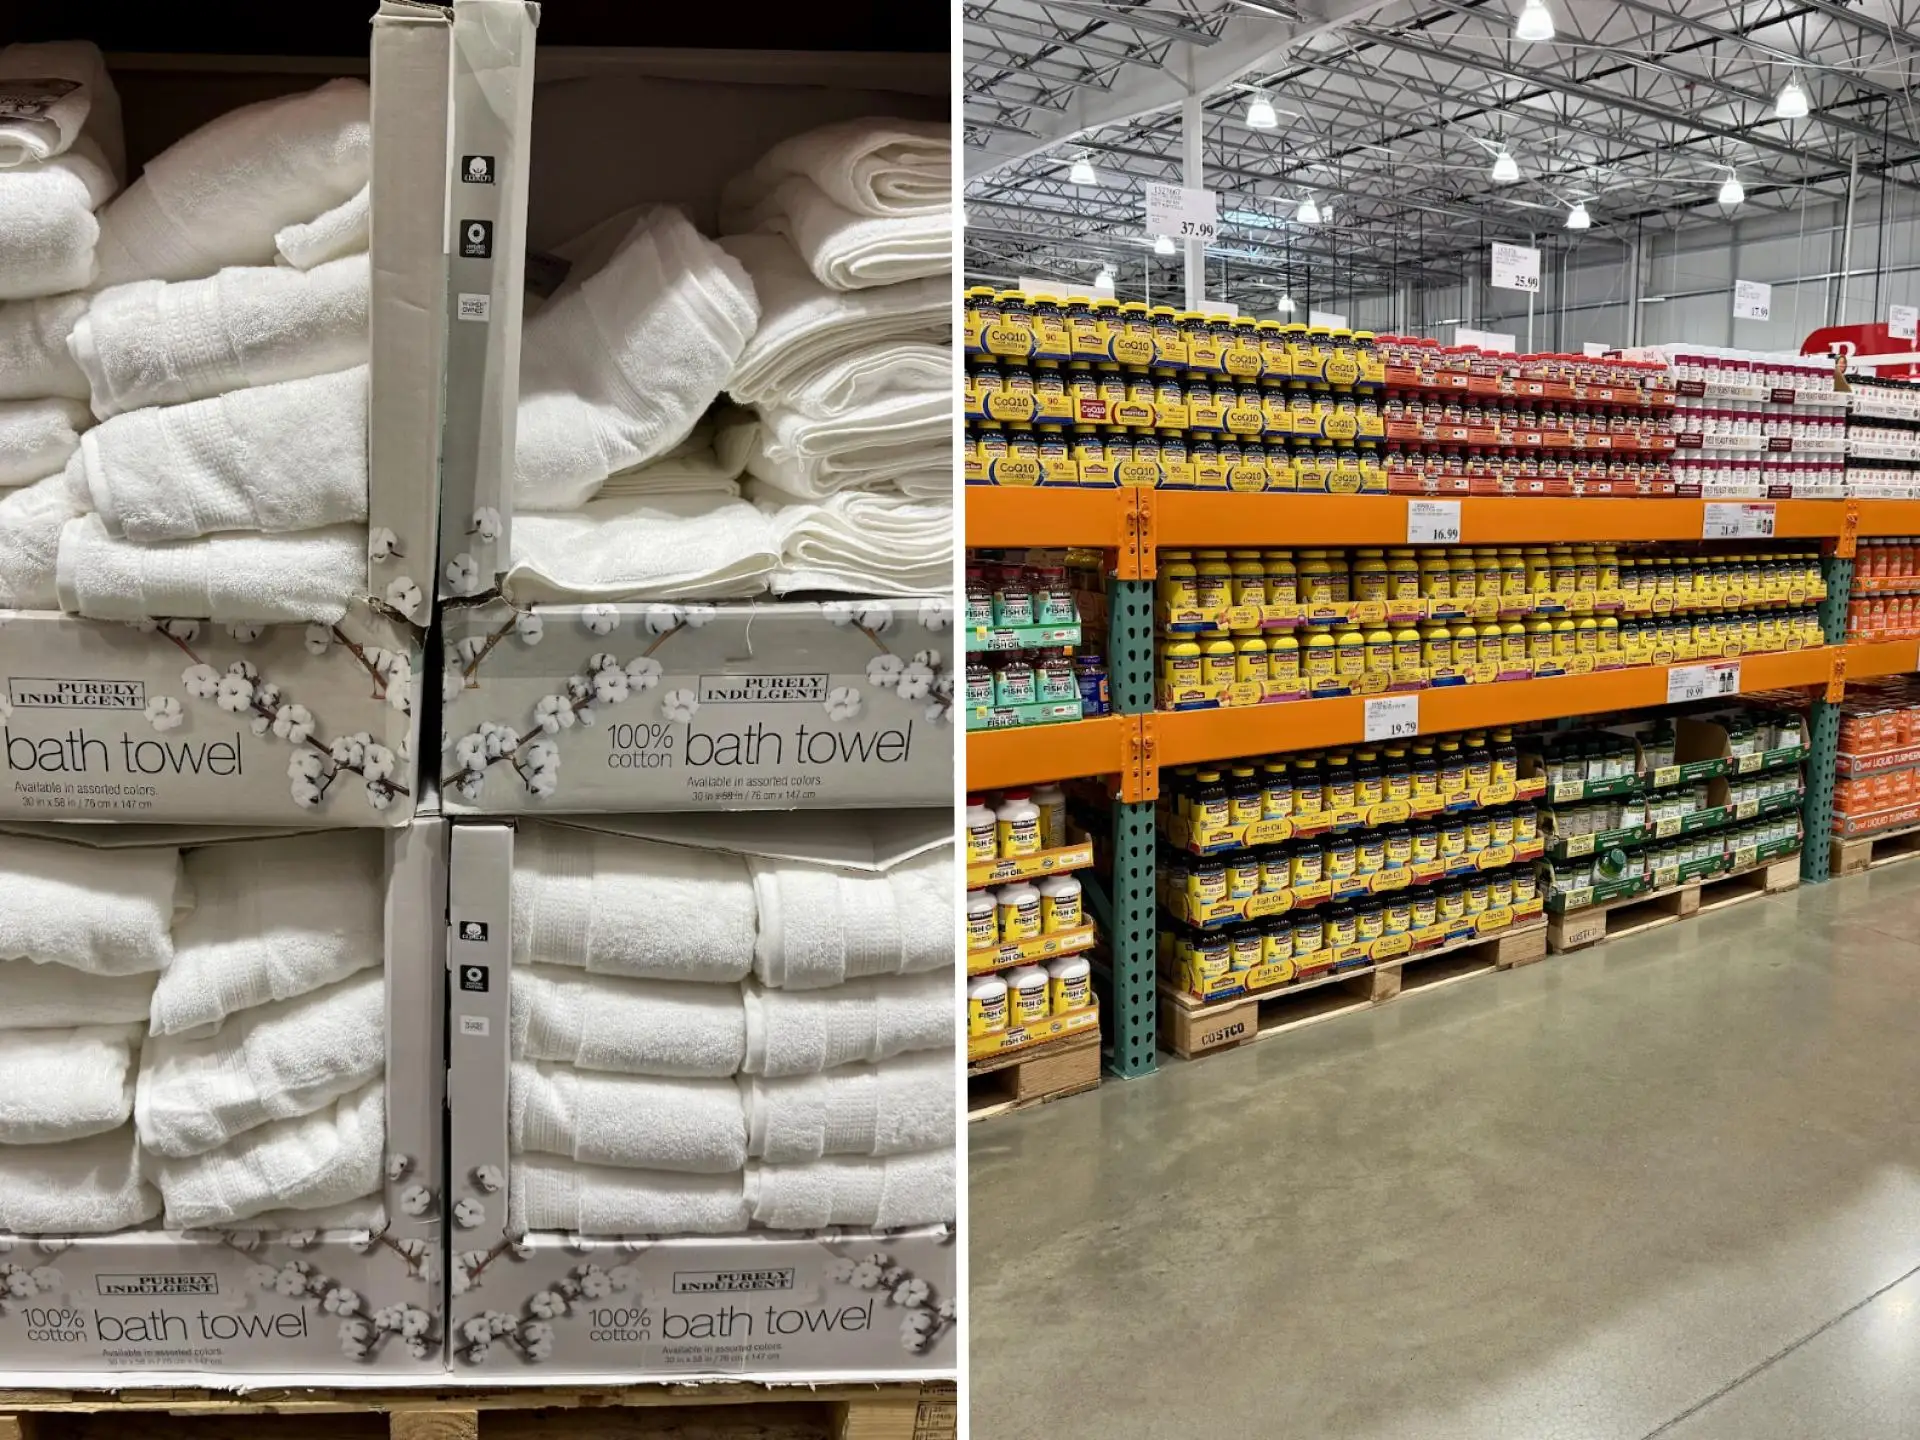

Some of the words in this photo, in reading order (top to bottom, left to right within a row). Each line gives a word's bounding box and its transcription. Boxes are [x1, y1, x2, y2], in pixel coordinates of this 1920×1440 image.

[1181, 222, 1214, 237] 37.99
[1515, 275, 1538, 288] 25.99
[992, 331, 1026, 342] CoQ10
[1118, 340, 1149, 351] CoQ10
[1229, 353, 1258, 364] CoQ10
[1330, 363, 1355, 373] CoQ10
[994, 397, 1028, 406] CoQ10
[1231, 413, 1258, 422] CoQ10
[1328, 419, 1354, 428] CoQ10
[1000, 463, 1034, 473] CoQ10
[1053, 462, 1064, 470] 90
[1124, 467, 1155, 475] CoQ10
[1235, 471, 1262, 481] CoQ10
[1333, 474, 1357, 483] CoQ10
[1433, 529, 1458, 540] 16.99
[988, 641, 1006, 649] FISH
[1008, 640, 1021, 648] OIL
[57, 682, 138, 695] PURELY
[745, 677, 822, 689] PURELY
[19, 692, 143, 706] INDULGENT
[706, 688, 824, 700] INDULGENT
[1391, 722, 1416, 735] 19.79
[608, 723, 673, 750] 100%
[685, 722, 782, 766] bath
[796, 720, 913, 764] towel
[5, 727, 107, 773] bath
[120, 732, 243, 776] towel
[607, 750, 672, 769] cotton
[1873, 756, 1894, 769] LIQUID
[687, 776, 731, 787] Available
[734, 777, 744, 787] in
[746, 776, 788, 787] assorted
[15, 781, 62, 793] Available
[64, 782, 74, 793] in
[77, 783, 120, 795] assorted
[123, 784, 158, 796] colors.
[692, 792, 703, 801] 30
[704, 791, 713, 801] in
[763, 792, 777, 800] cm
[786, 790, 800, 799] 147
[802, 791, 816, 799] cm
[23, 797, 33, 807] 30
[37, 798, 45, 807] in
[67, 798, 75, 808] in
[85, 798, 95, 808] 76
[97, 800, 111, 808] cm
[122, 800, 135, 809] 147
[138, 801, 152, 809] cm
[1867, 815, 1888, 828] LIQUID
[989, 870, 1009, 879] FISH
[1010, 868, 1024, 877] OIL
[992, 954, 1012, 964] FISH
[1061, 990, 1078, 998] FISH
[978, 1011, 998, 1019] FISH
[1202, 1022, 1245, 1046] COSTCO
[1000, 1038, 1019, 1047] FISH
[1020, 1034, 1033, 1042] OIL
[139, 1276, 212, 1286] PURELY
[717, 1271, 790, 1283] PURELY
[105, 1283, 214, 1294] INDULGENT
[680, 1279, 792, 1292] INDULGENT
[22, 1308, 85, 1328] 100%
[94, 1308, 187, 1342] bath
[201, 1306, 308, 1340] towel
[588, 1308, 652, 1330] 100%
[662, 1306, 752, 1340] bath
[767, 1298, 873, 1335] towel
[27, 1328, 88, 1342] cotton
[589, 1327, 651, 1342] cotton
[102, 1348, 142, 1357] Available
[155, 1348, 192, 1356] assorted
[662, 1345, 701, 1354] Available
[703, 1345, 712, 1353] in
[715, 1345, 752, 1353] assorted
